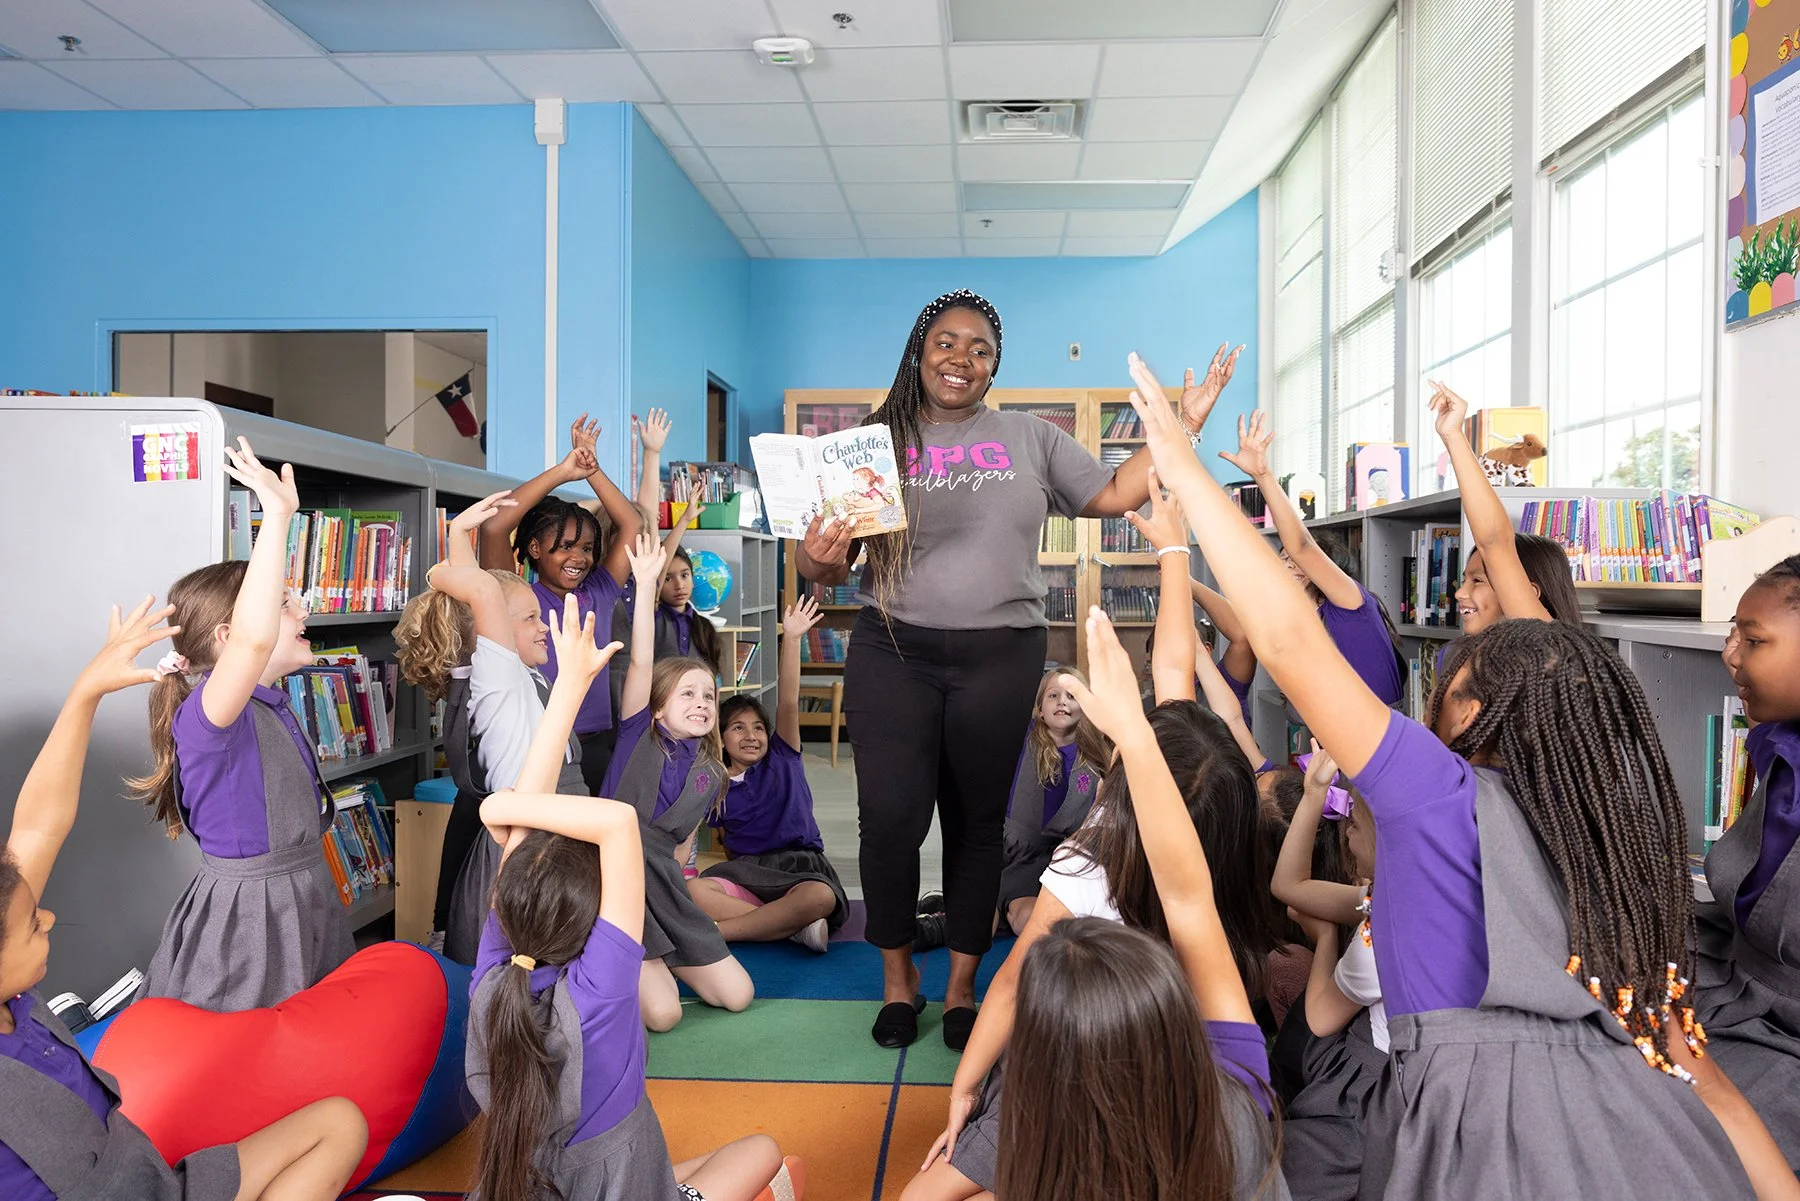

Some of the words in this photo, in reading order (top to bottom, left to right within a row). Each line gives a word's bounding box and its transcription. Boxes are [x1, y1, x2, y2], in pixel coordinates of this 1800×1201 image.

[143, 437, 188, 452] GNC
[822, 436, 889, 464] Charlotte's
[143, 452, 188, 461] GRAPHIC
[842, 449, 874, 470] Web
[144, 463, 188, 474] NOVELS
